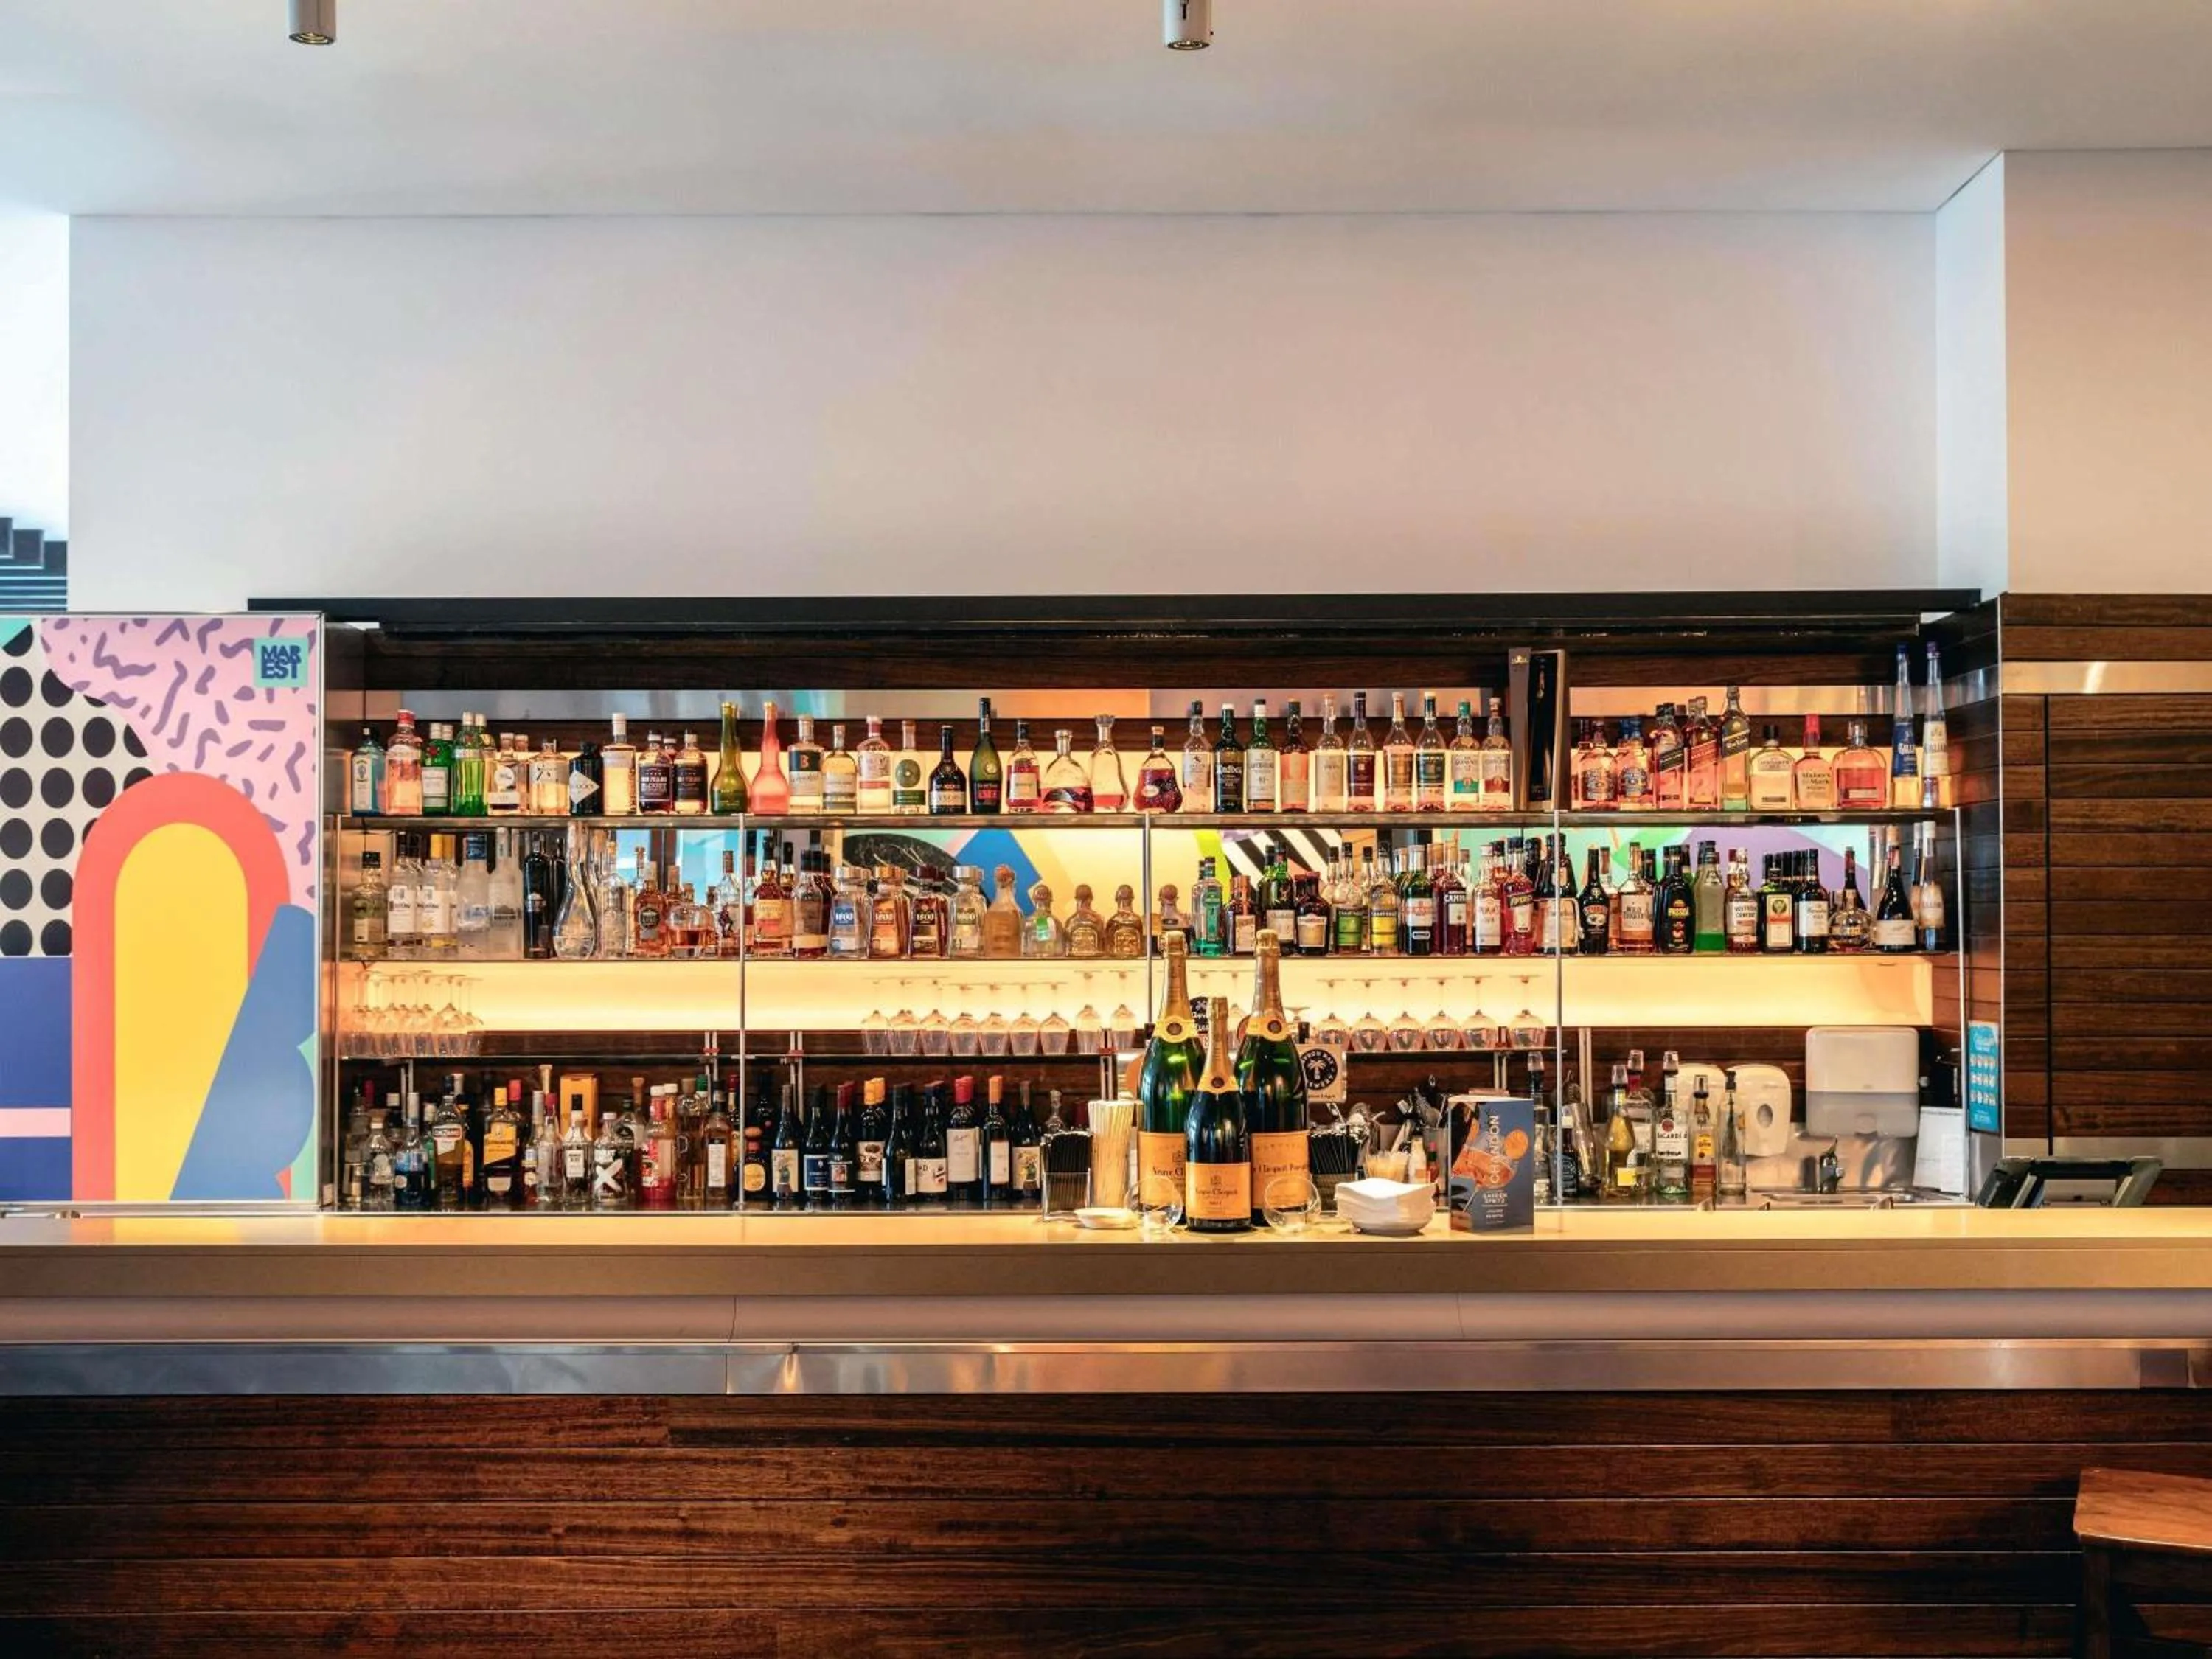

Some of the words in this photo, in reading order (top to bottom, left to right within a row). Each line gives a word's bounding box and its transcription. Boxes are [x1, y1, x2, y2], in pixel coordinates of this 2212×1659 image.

[260, 645, 302, 664] MAR
[260, 661, 298, 679] EST
[1489, 1115, 1500, 1183] CHANDON
